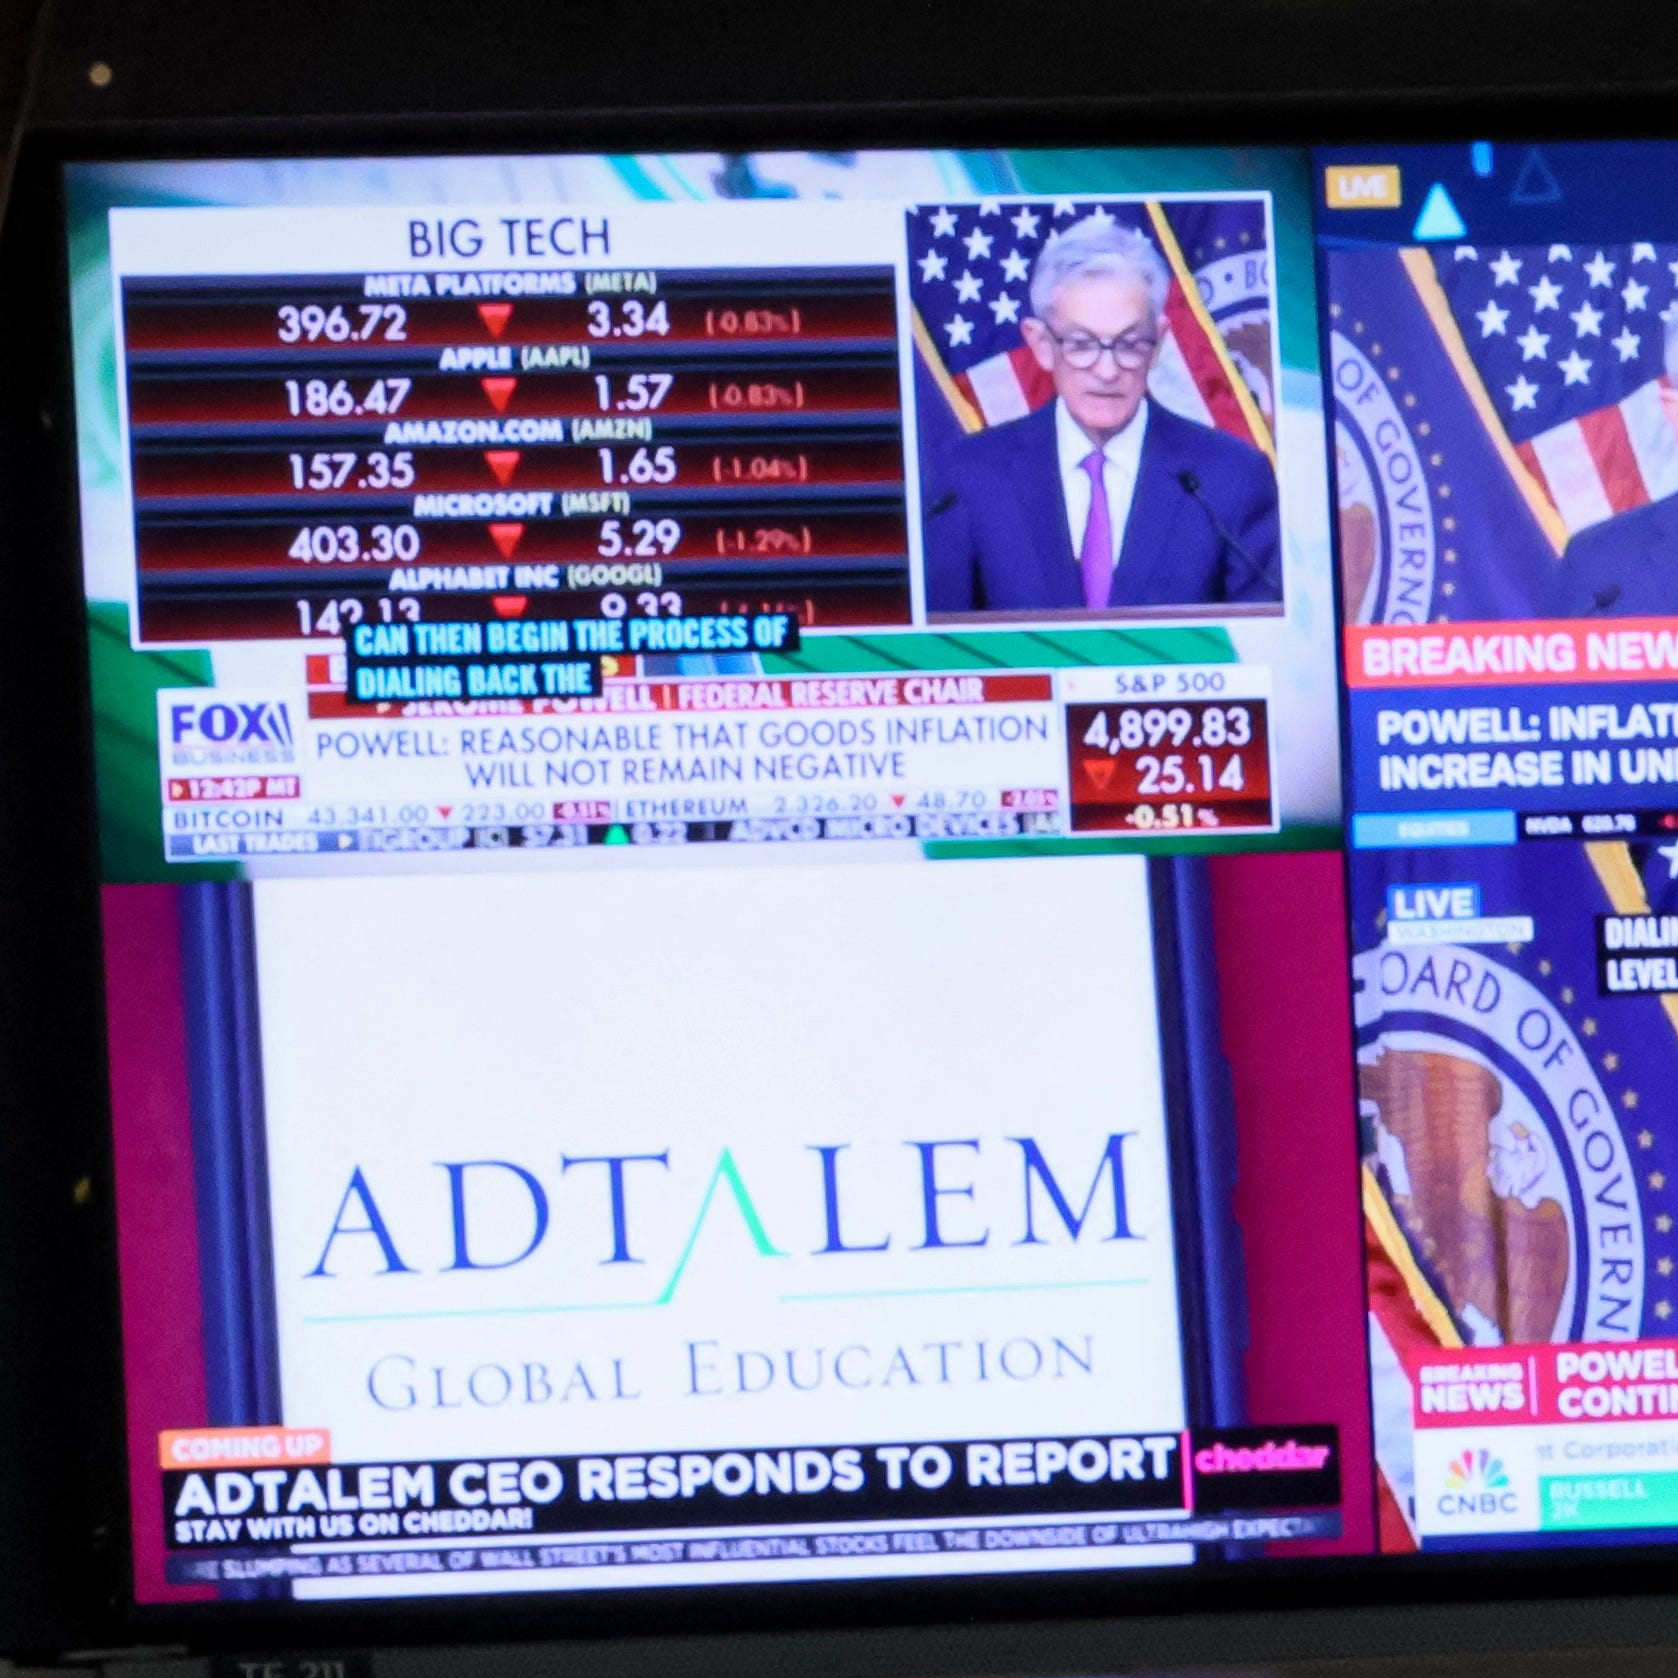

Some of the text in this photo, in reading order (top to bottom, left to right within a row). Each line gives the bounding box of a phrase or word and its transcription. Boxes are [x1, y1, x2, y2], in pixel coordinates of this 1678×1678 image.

[408, 217, 611, 257] BIG TECH
[365, 271, 576, 297] META PLATFORMS
[278, 303, 406, 342] 396.72
[587, 300, 670, 338] 3.34
[439, 345, 512, 371] APPLE
[285, 378, 412, 417] 186.47
[596, 374, 673, 410] 1.57
[384, 419, 563, 445] AMAZON.COM
[289, 452, 414, 490] 157.35
[598, 448, 677, 484] 1.65
[413, 493, 553, 518] MICROSOFT
[288, 525, 419, 564] 403.30
[597, 520, 681, 557] 5.29
[514, 565, 560, 589] INC
[354, 615, 789, 656] CAN THEN BEGIN THE PROCESS OF
[1363, 637, 1575, 677] BREAKING
[356, 662, 593, 699] DIALING BACK THE
[678, 681, 784, 711] FEDERAL
[790, 678, 898, 707] RESERVE
[903, 676, 985, 704] CHAIR
[1116, 672, 1224, 693] S&P 500
[171, 704, 269, 744] FOX
[317, 715, 1048, 758] POWELL: REASONABLE THAT GOODS INFLATION
[1083, 708, 1251, 754] 4,899.83
[1378, 707, 1540, 744] POWELL:
[465, 752, 906, 787] WILL NOT REMAIN NEGATIVE
[1136, 755, 1244, 794] 25.14
[1379, 751, 1564, 791] INCREASE
[1571, 750, 1612, 785] IN
[174, 810, 284, 829] BITCOIN
[1126, 805, 1218, 829] -0.51%
[1394, 888, 1474, 919] LIVE
[302, 1130, 1147, 1304] ADTALEM
[367, 1334, 1096, 1414] GLOBAL EDUCATION
[1421, 1383, 1525, 1413] NEWS
[171, 1431, 324, 1461] COMING UP
[1195, 1442, 1331, 1474] cheddar
[174, 1437, 1176, 1515] ADTALEM CEO RESPONDS TO REPORT
[1438, 1492, 1518, 1516] CNBC
[175, 1508, 534, 1543] STAY WITH US ON CHEDDAR!
